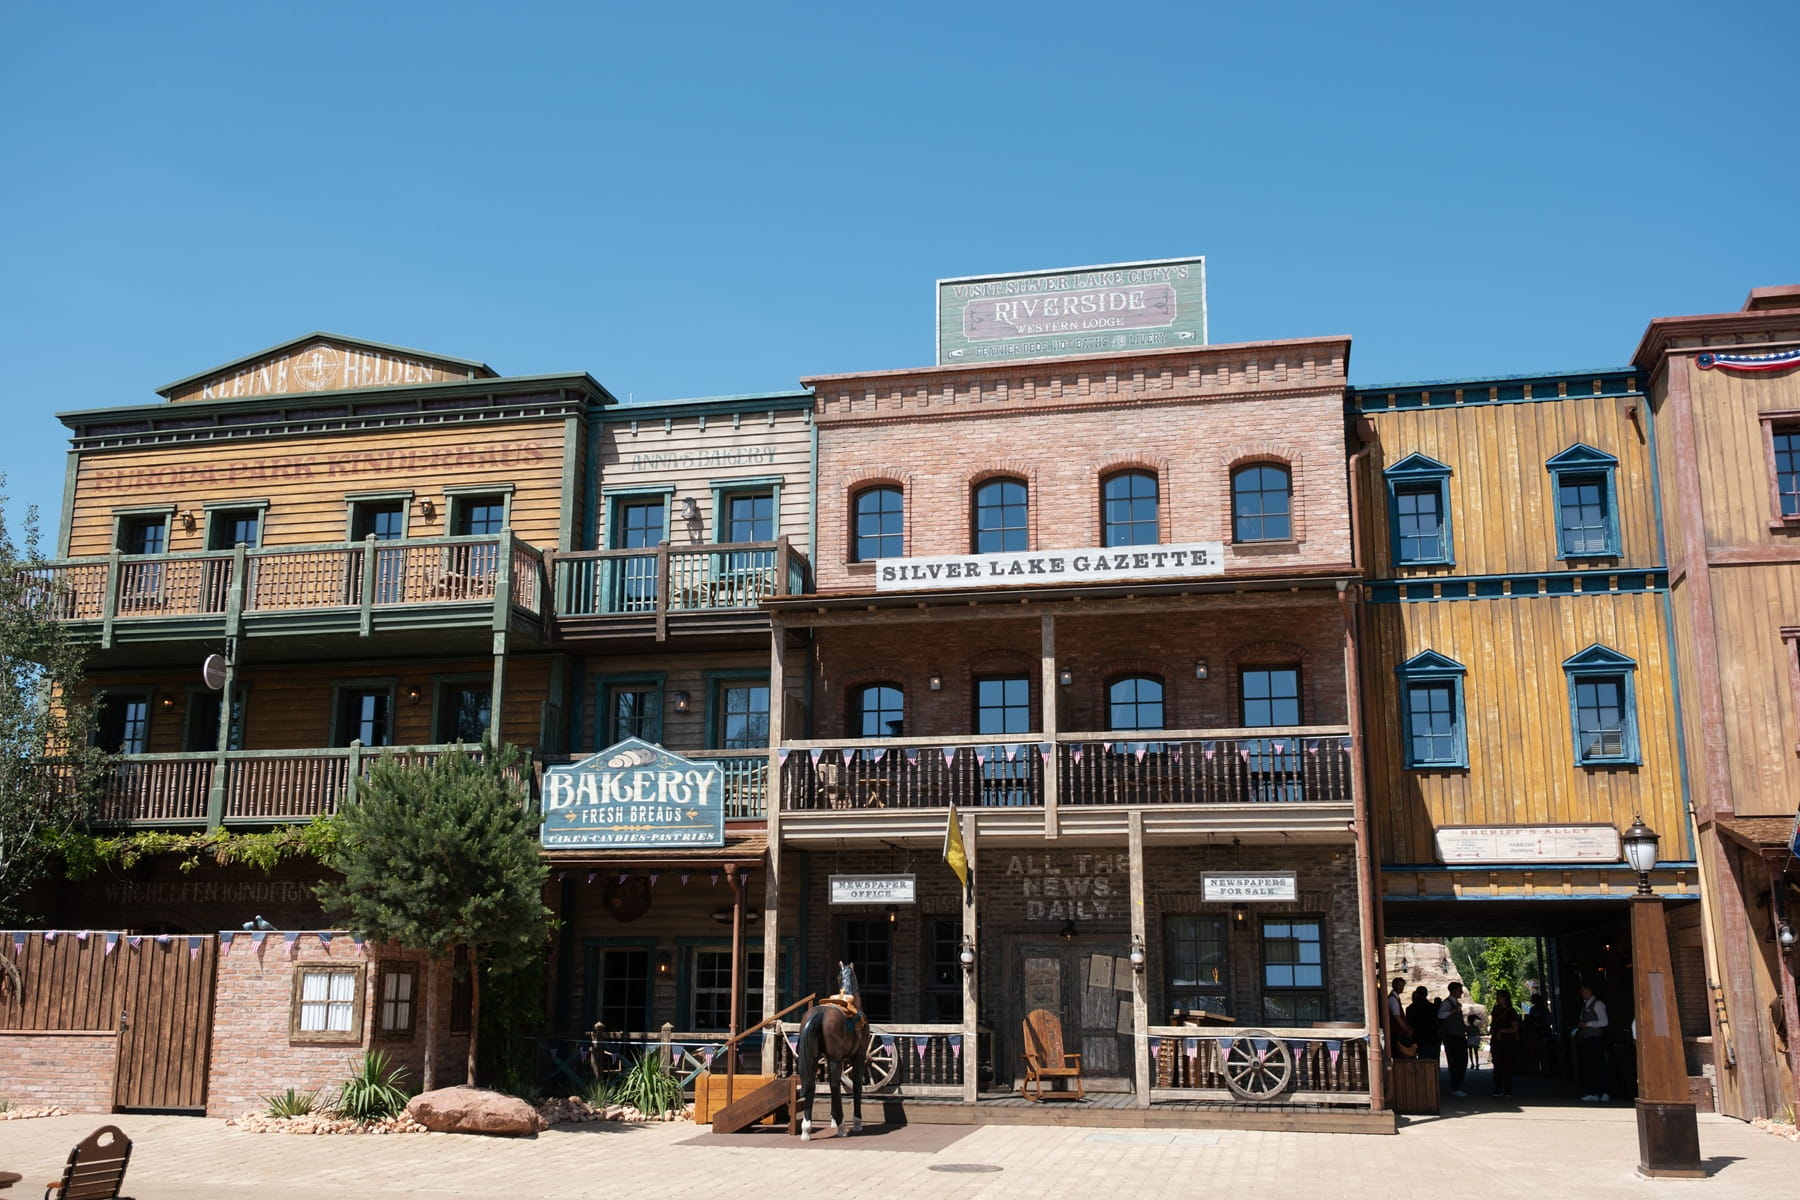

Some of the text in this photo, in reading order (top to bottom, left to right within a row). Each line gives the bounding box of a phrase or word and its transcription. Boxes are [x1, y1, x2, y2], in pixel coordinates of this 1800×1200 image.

[953, 265, 1189, 299] VISIT SILVER LAKE CITY'S
[994, 290, 1147, 325] RIVERSIDE
[1016, 316, 1127, 335] WESTERN LODGE
[202, 355, 290, 400] KLEINE
[342, 348, 434, 388] HELDEN
[94, 442, 545, 494] EUROPA-PARK KINDERHAUS
[698, 447, 777, 467] BAKERY
[882, 549, 1216, 582] SILVER LAKE GAZETTE.
[549, 769, 715, 811] BAKERY
[582, 806, 682, 824] FRESH BREADS
[1006, 854, 1130, 876] ALL THE
[838, 881, 907, 889] NEWSPAPER
[1210, 879, 1286, 887] NEWSPAPERS
